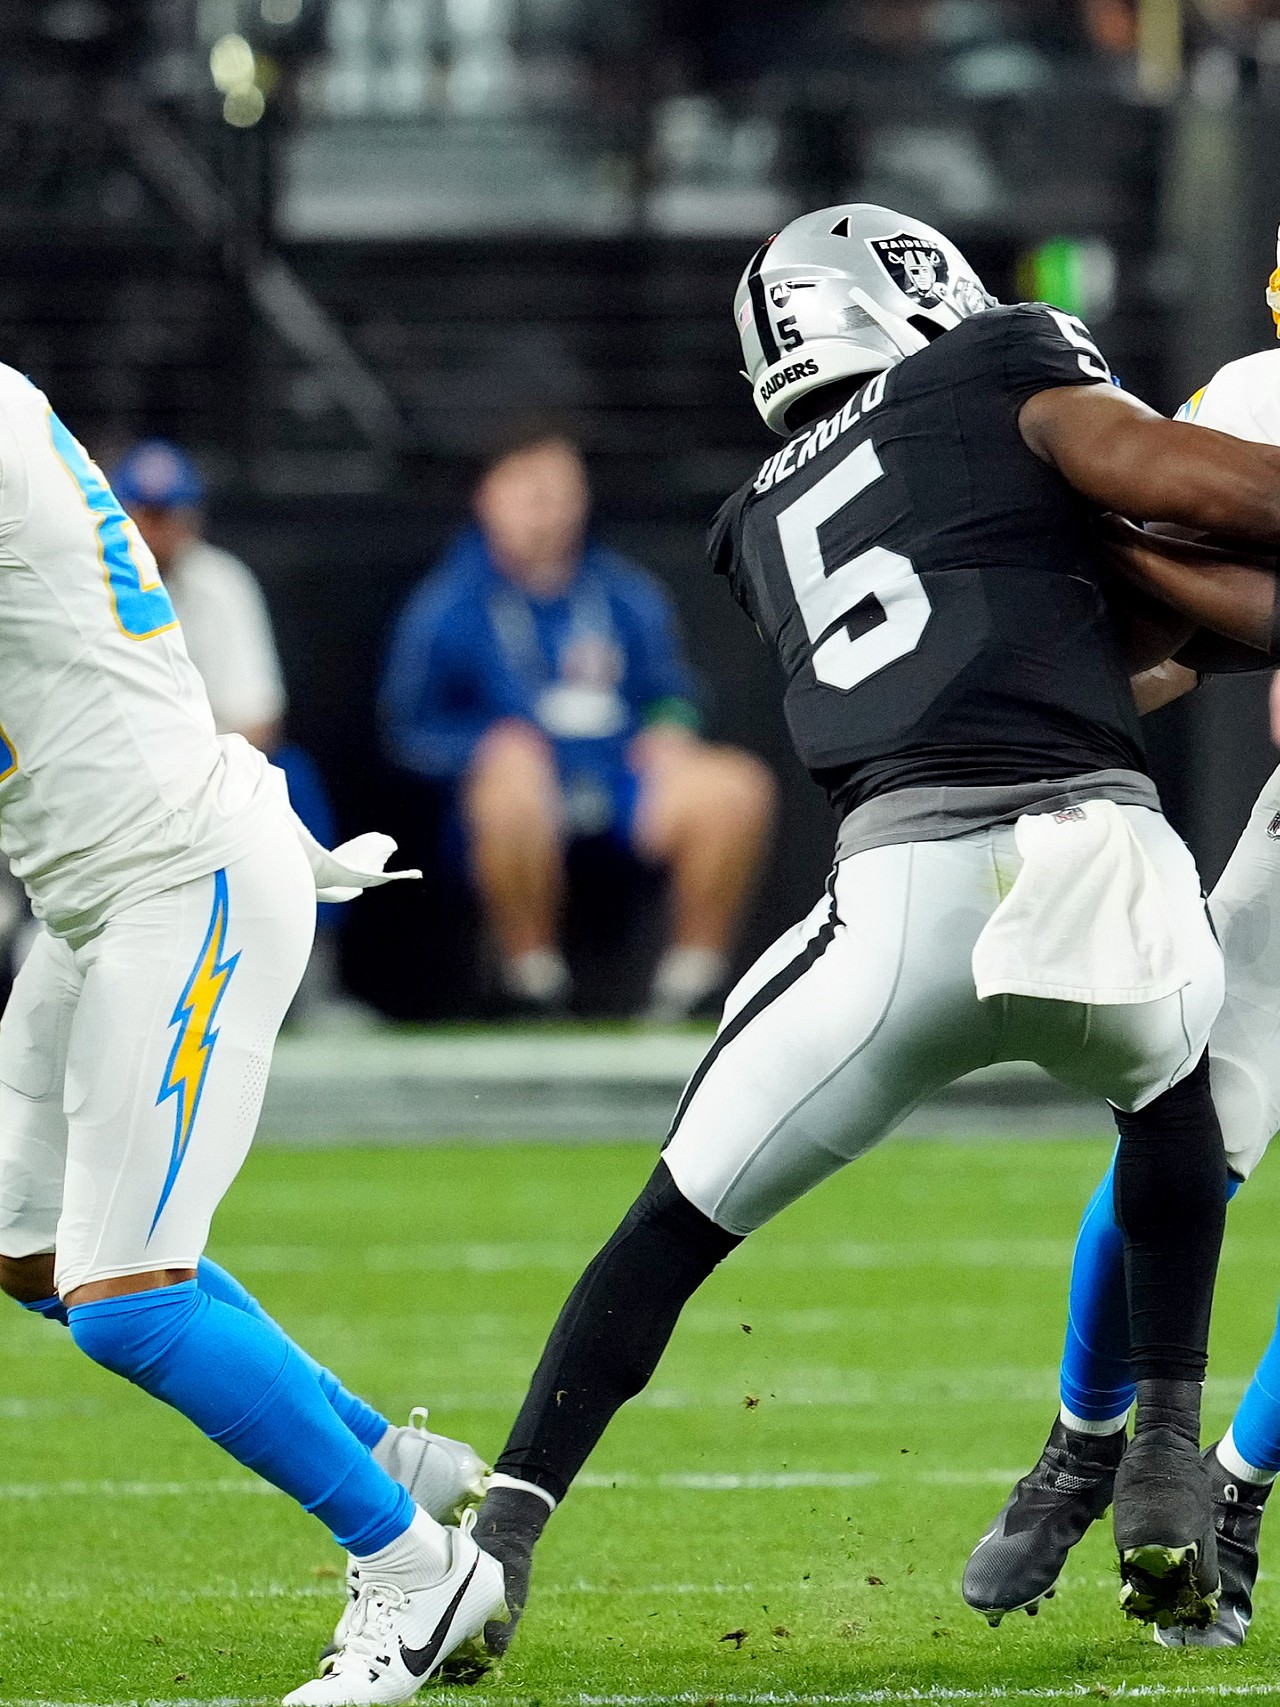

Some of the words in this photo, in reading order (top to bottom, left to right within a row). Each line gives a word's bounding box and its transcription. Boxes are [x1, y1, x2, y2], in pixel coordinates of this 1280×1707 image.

[878, 240, 938, 250] RAIDERS
[776, 315, 804, 353] 5
[1046, 310, 1113, 385] 5
[760, 358, 819, 404] RAIDERS
[775, 438, 932, 691] 5
